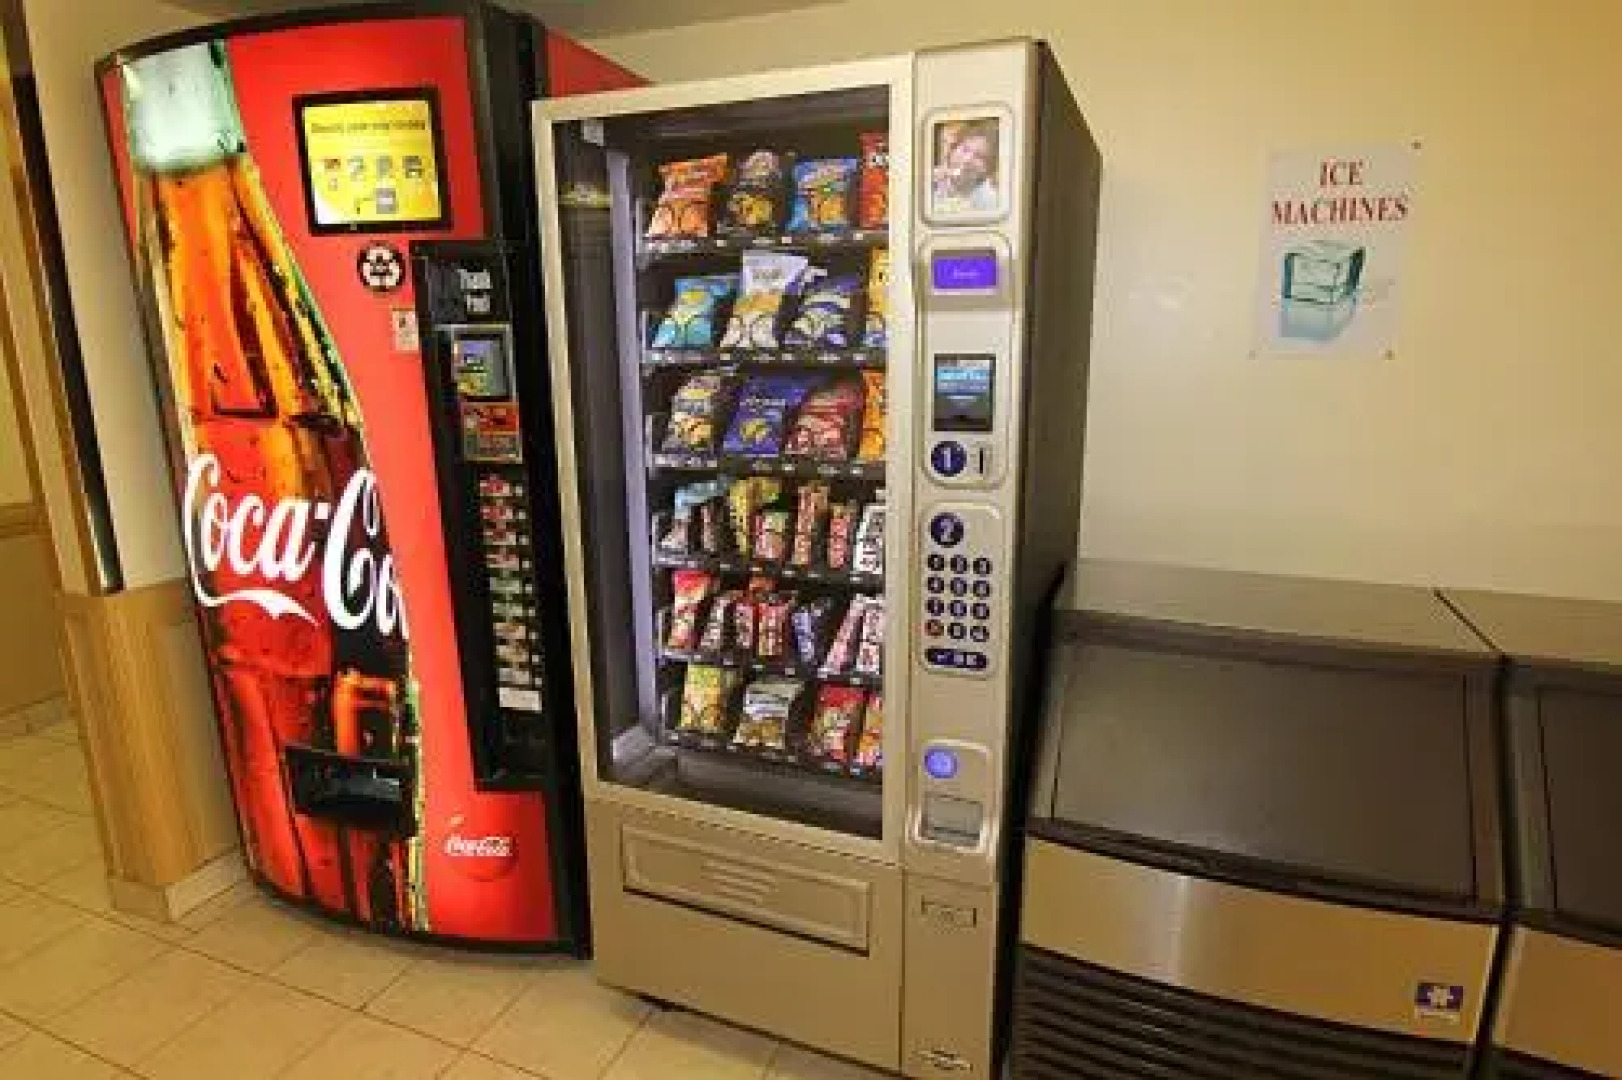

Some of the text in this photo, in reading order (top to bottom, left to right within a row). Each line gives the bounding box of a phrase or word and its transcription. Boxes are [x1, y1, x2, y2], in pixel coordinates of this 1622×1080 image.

[1319, 160, 1365, 186] ICE
[1271, 195, 1410, 224] MACHINES
[183, 453, 410, 640] Coca-Co
